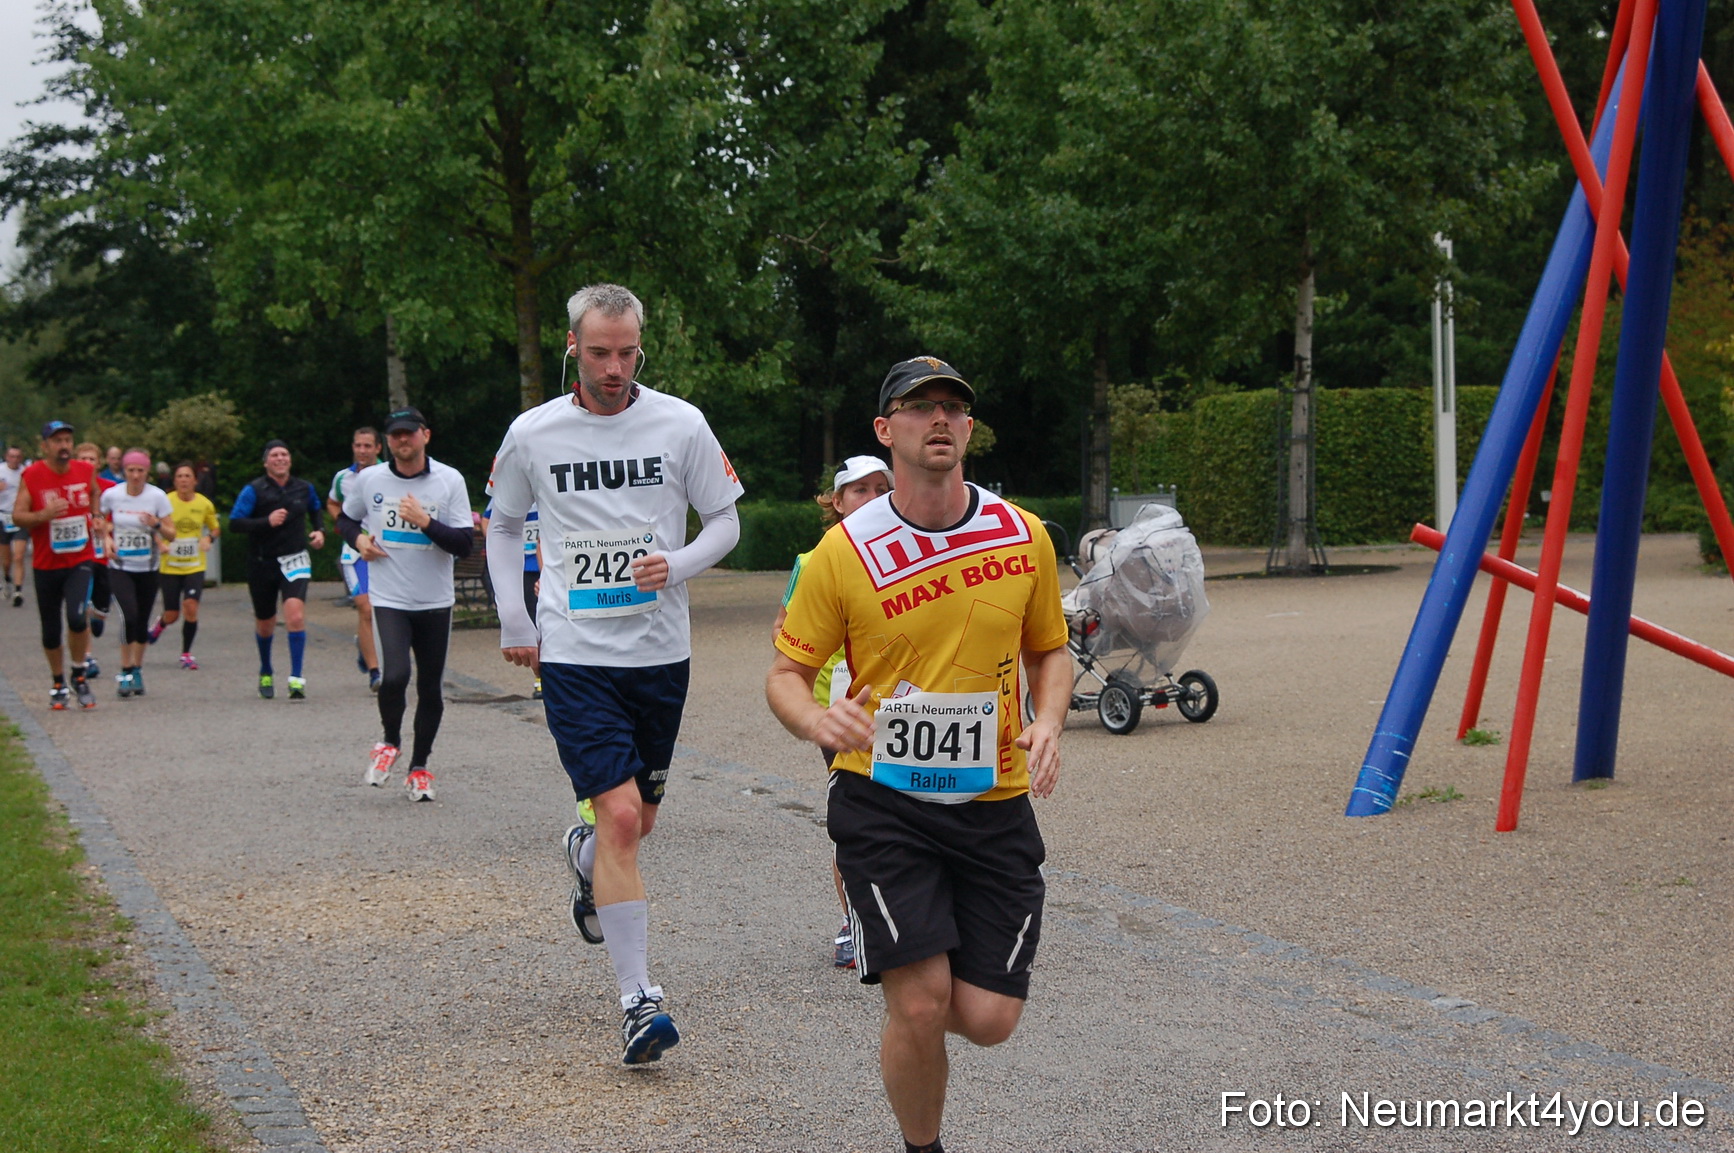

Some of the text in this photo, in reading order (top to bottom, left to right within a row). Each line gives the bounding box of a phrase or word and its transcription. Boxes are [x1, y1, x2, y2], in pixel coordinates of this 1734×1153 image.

[550, 456, 663, 493] THULE
[632, 476, 661, 486] SWEDEN
[565, 536, 641, 550] PARTL Neumarkt
[881, 554, 1036, 620] MAX BÖGL
[596, 591, 632, 606] Muris
[922, 703, 978, 716] Neumarkt
[886, 718, 982, 762] 3041
[910, 771, 957, 792] Ralph
